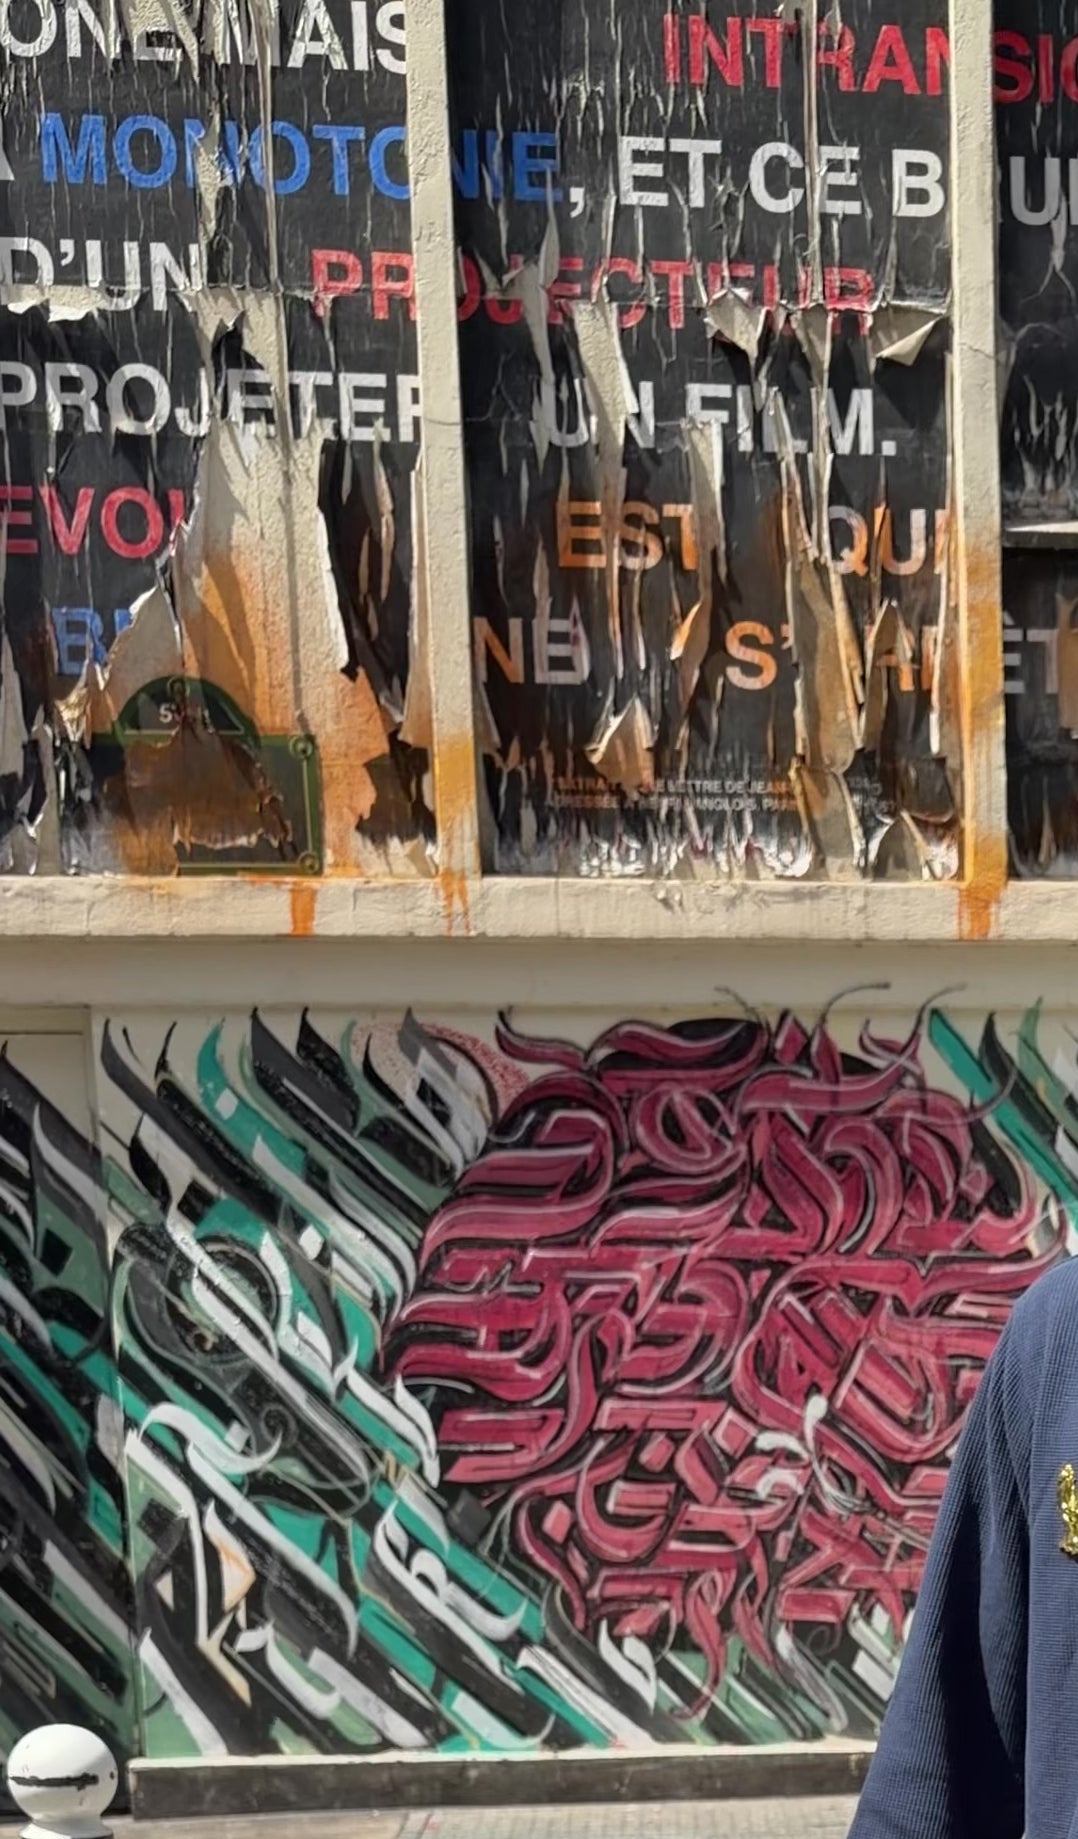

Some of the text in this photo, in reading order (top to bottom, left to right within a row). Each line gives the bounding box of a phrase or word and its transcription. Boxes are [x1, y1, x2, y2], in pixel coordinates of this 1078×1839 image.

[619, 136, 722, 208] ET
[749, 142, 864, 216] CE
[0, 236, 201, 313] D'UN
[556, 500, 699, 571] EST
